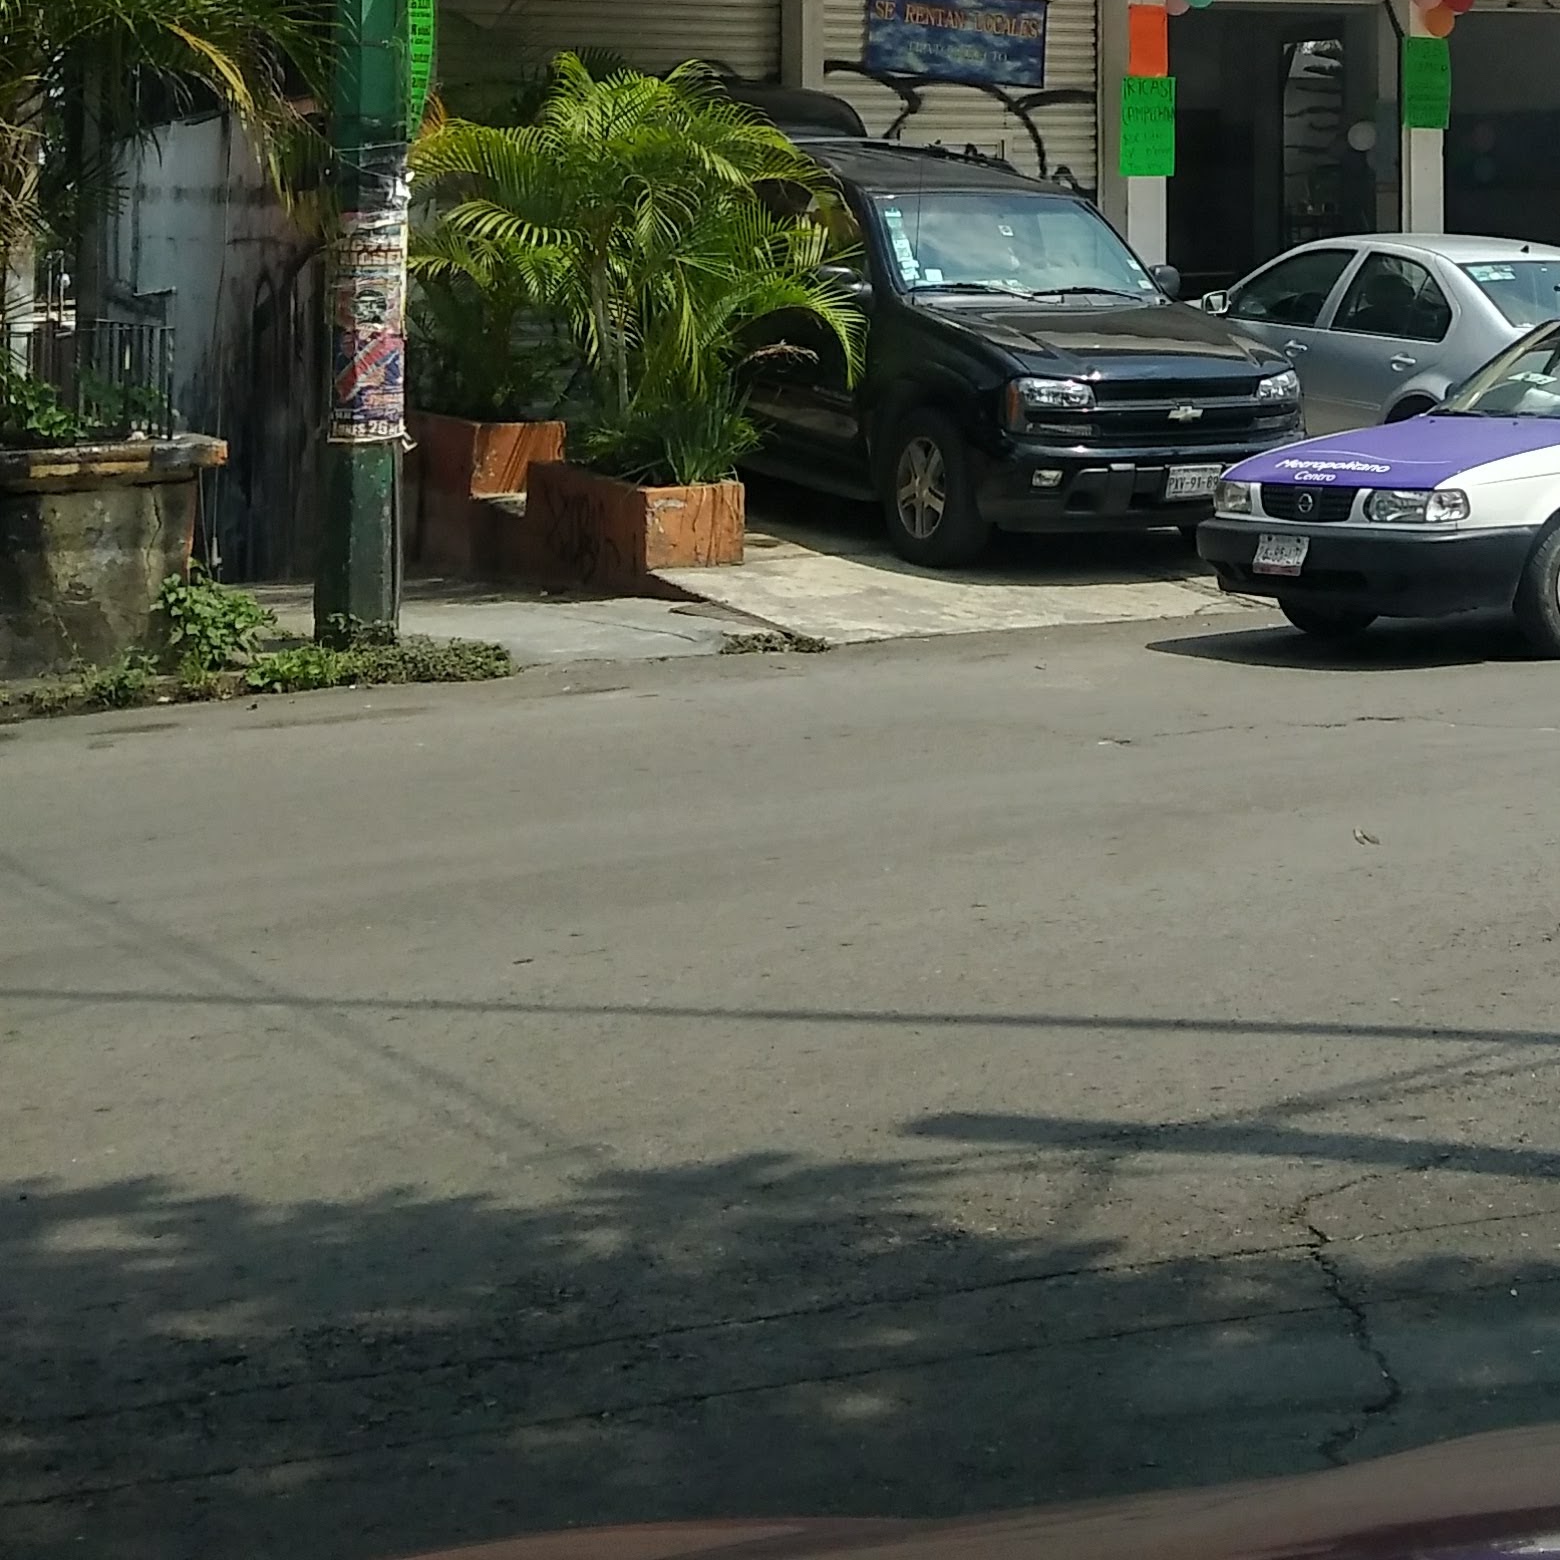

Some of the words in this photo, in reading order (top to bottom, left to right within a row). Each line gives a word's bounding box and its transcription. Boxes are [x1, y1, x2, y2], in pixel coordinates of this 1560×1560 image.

[875, 0, 896, 21] SE
[904, 3, 966, 29] RENTAN
[975, 12, 1040, 39] LOCALES
[1274, 459, 1391, 473] Metropolitano
[1294, 470, 1337, 482] Centro
